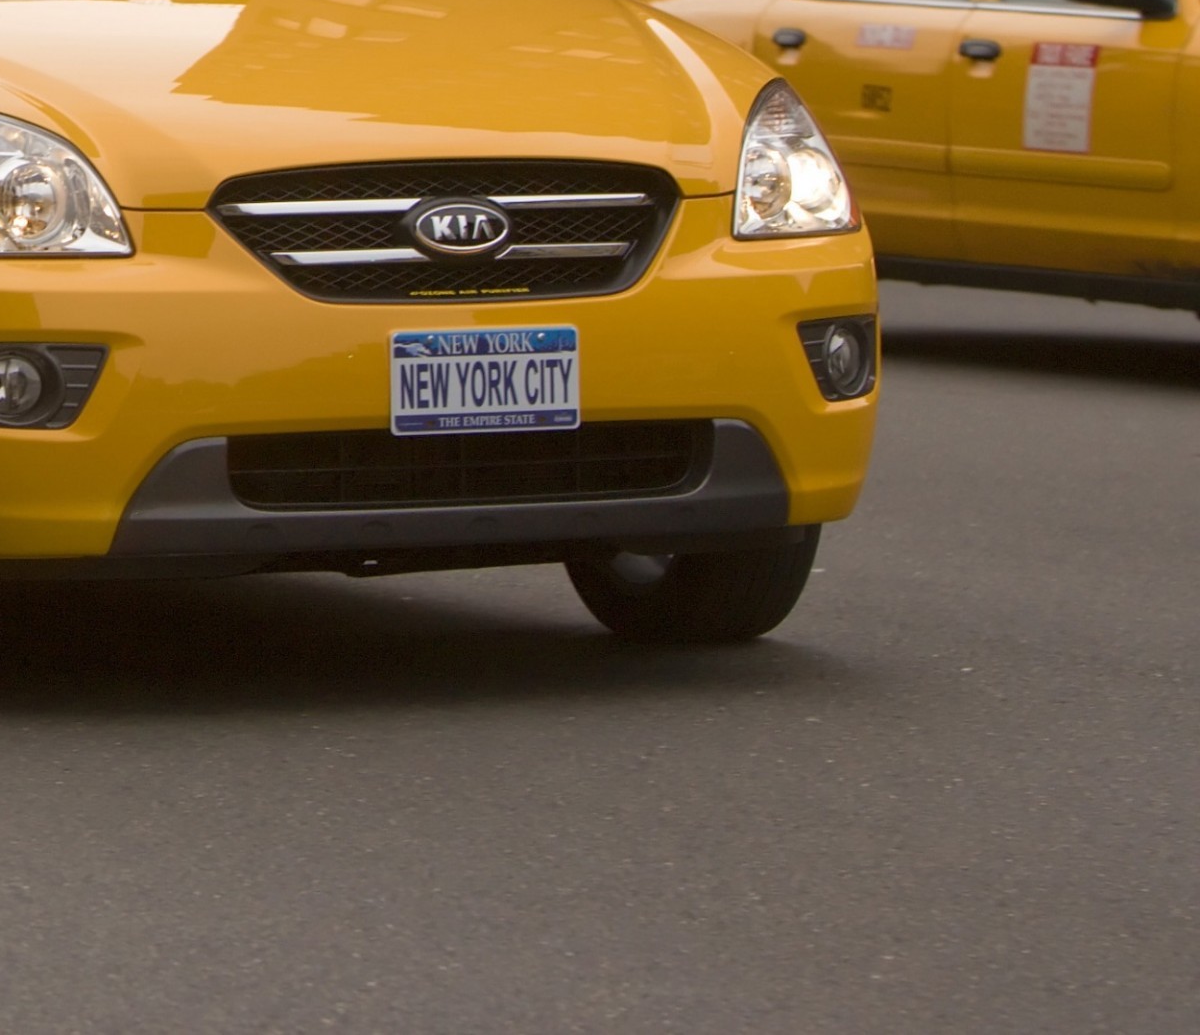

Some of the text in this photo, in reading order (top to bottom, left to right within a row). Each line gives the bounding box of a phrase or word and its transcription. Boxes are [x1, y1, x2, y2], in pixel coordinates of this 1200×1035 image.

[430, 214, 495, 241] KIA
[436, 332, 536, 355] NEW YORK
[400, 358, 573, 410] NEW YORK CITY
[438, 414, 536, 428] THE EMPIRE STATE
